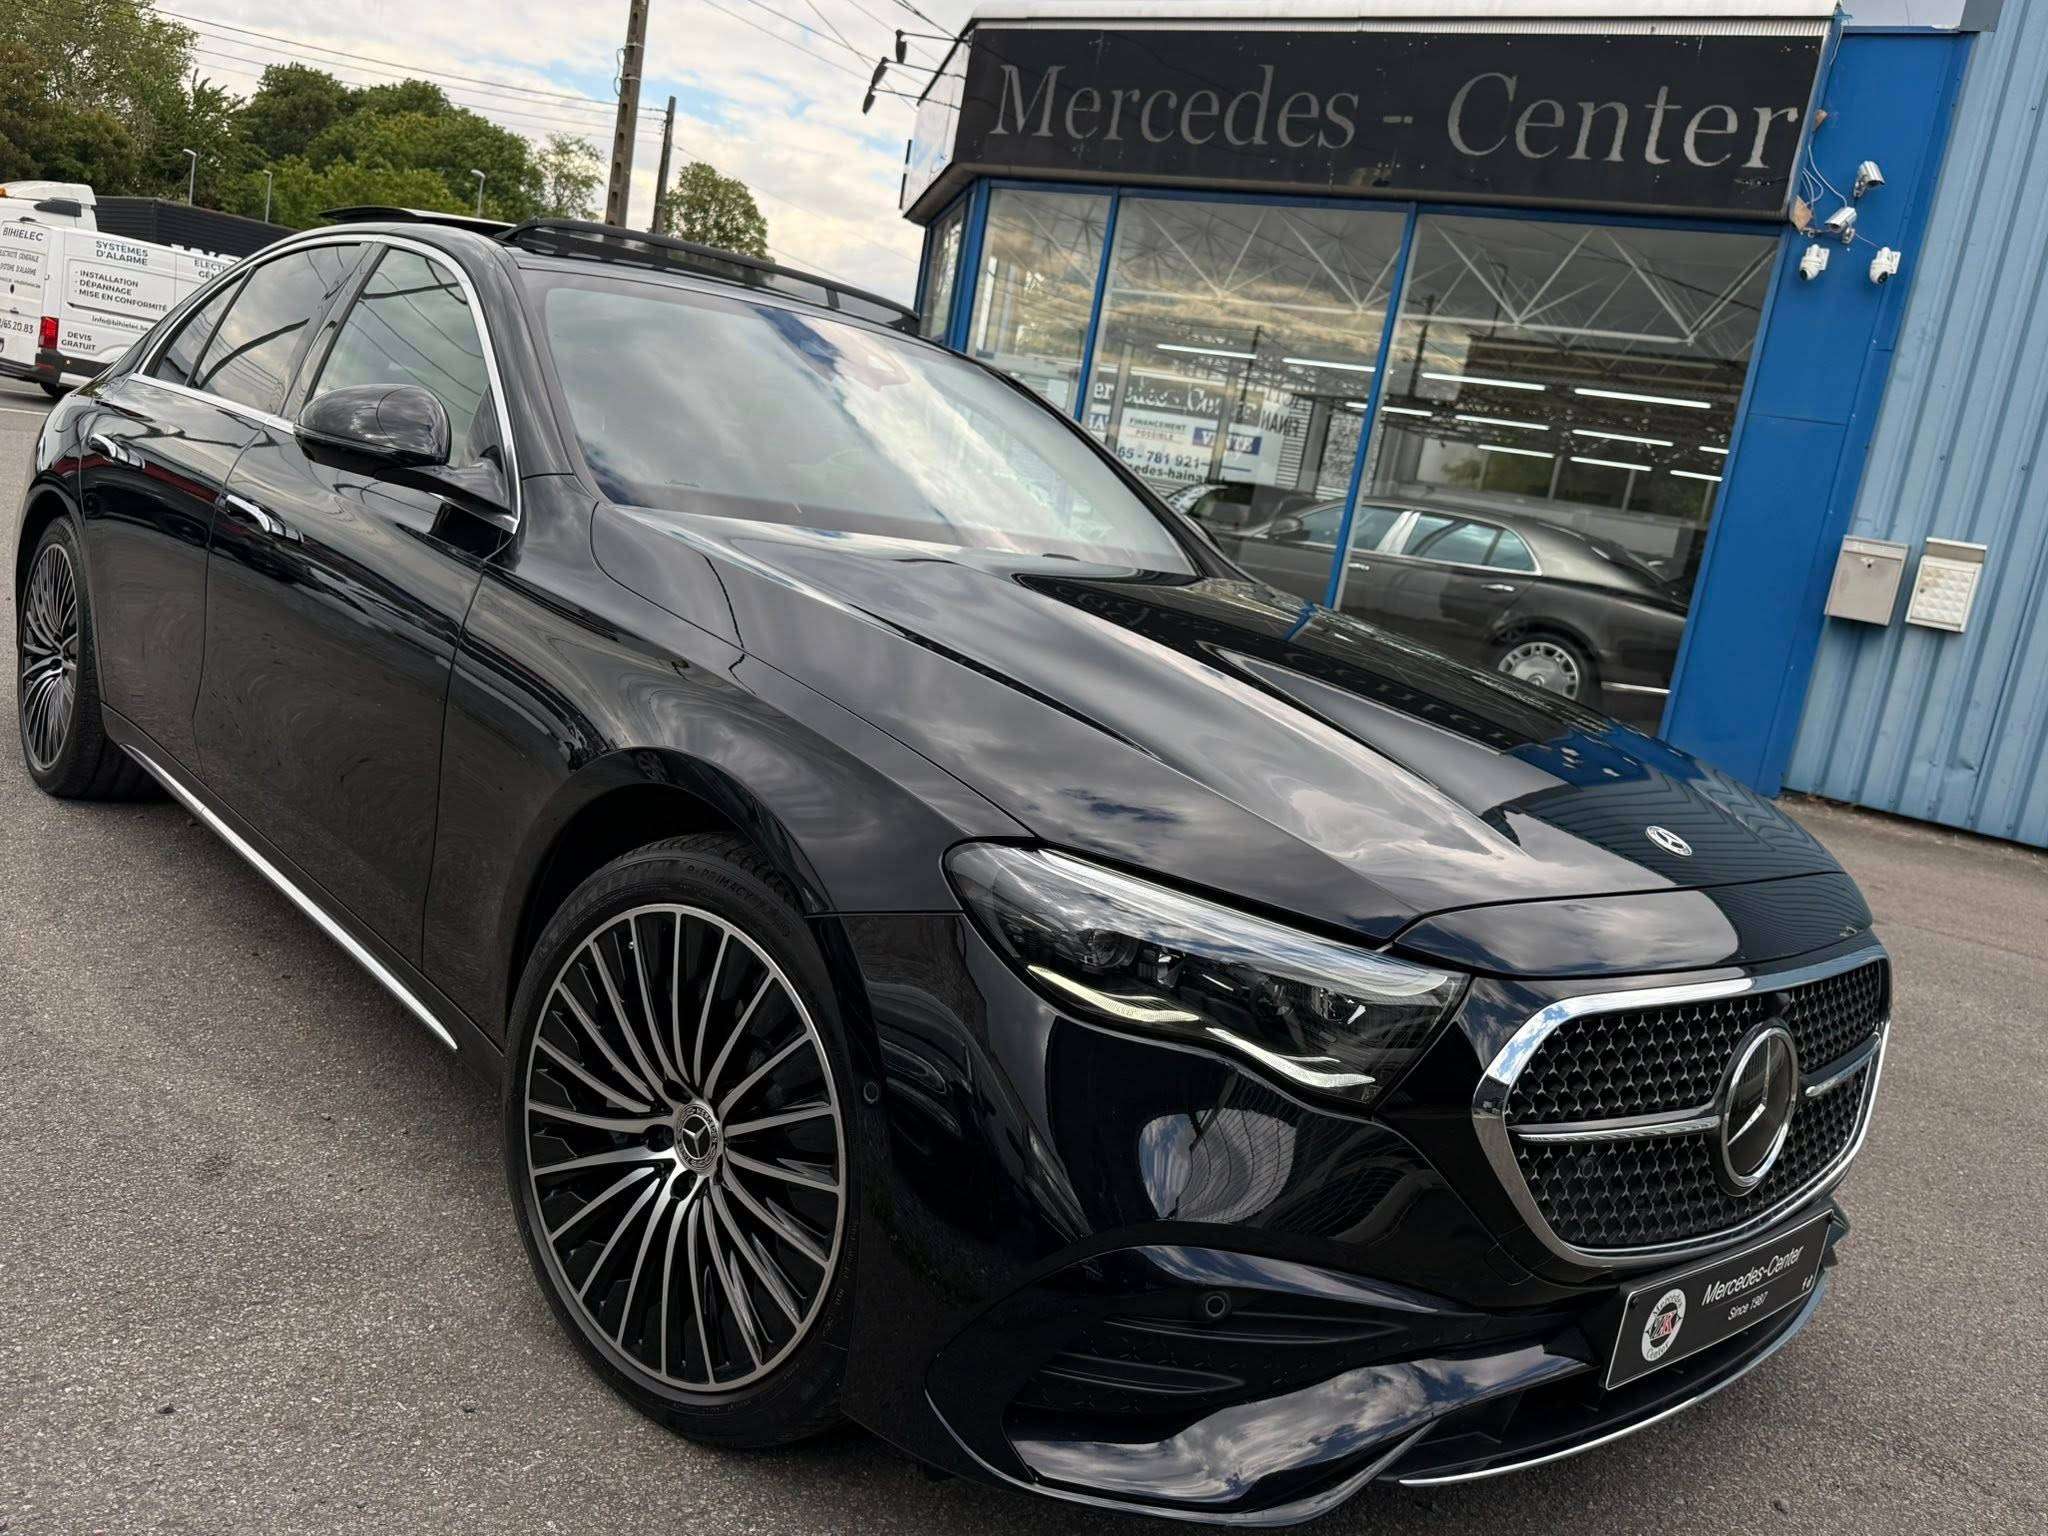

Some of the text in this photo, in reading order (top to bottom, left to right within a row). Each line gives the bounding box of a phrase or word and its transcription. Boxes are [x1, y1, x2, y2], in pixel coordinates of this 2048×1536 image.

[988, 63, 1360, 150] Mercedes
[1446, 71, 1799, 169] Center
[2, 226, 44, 242] BIHIELEC
[95, 249, 149, 266] D'ALARME
[79, 269, 139, 288] INSTALLATION
[78, 288, 100, 299] MISE
[101, 293, 114, 302] EN
[67, 331, 93, 342] DEVIS
[61, 339, 96, 351] GRATUIT
[1146, 450, 1170, 465] 781
[1701, 1246, 1804, 1307] Mercedes-Center
[1727, 1303, 1750, 1321] Since
